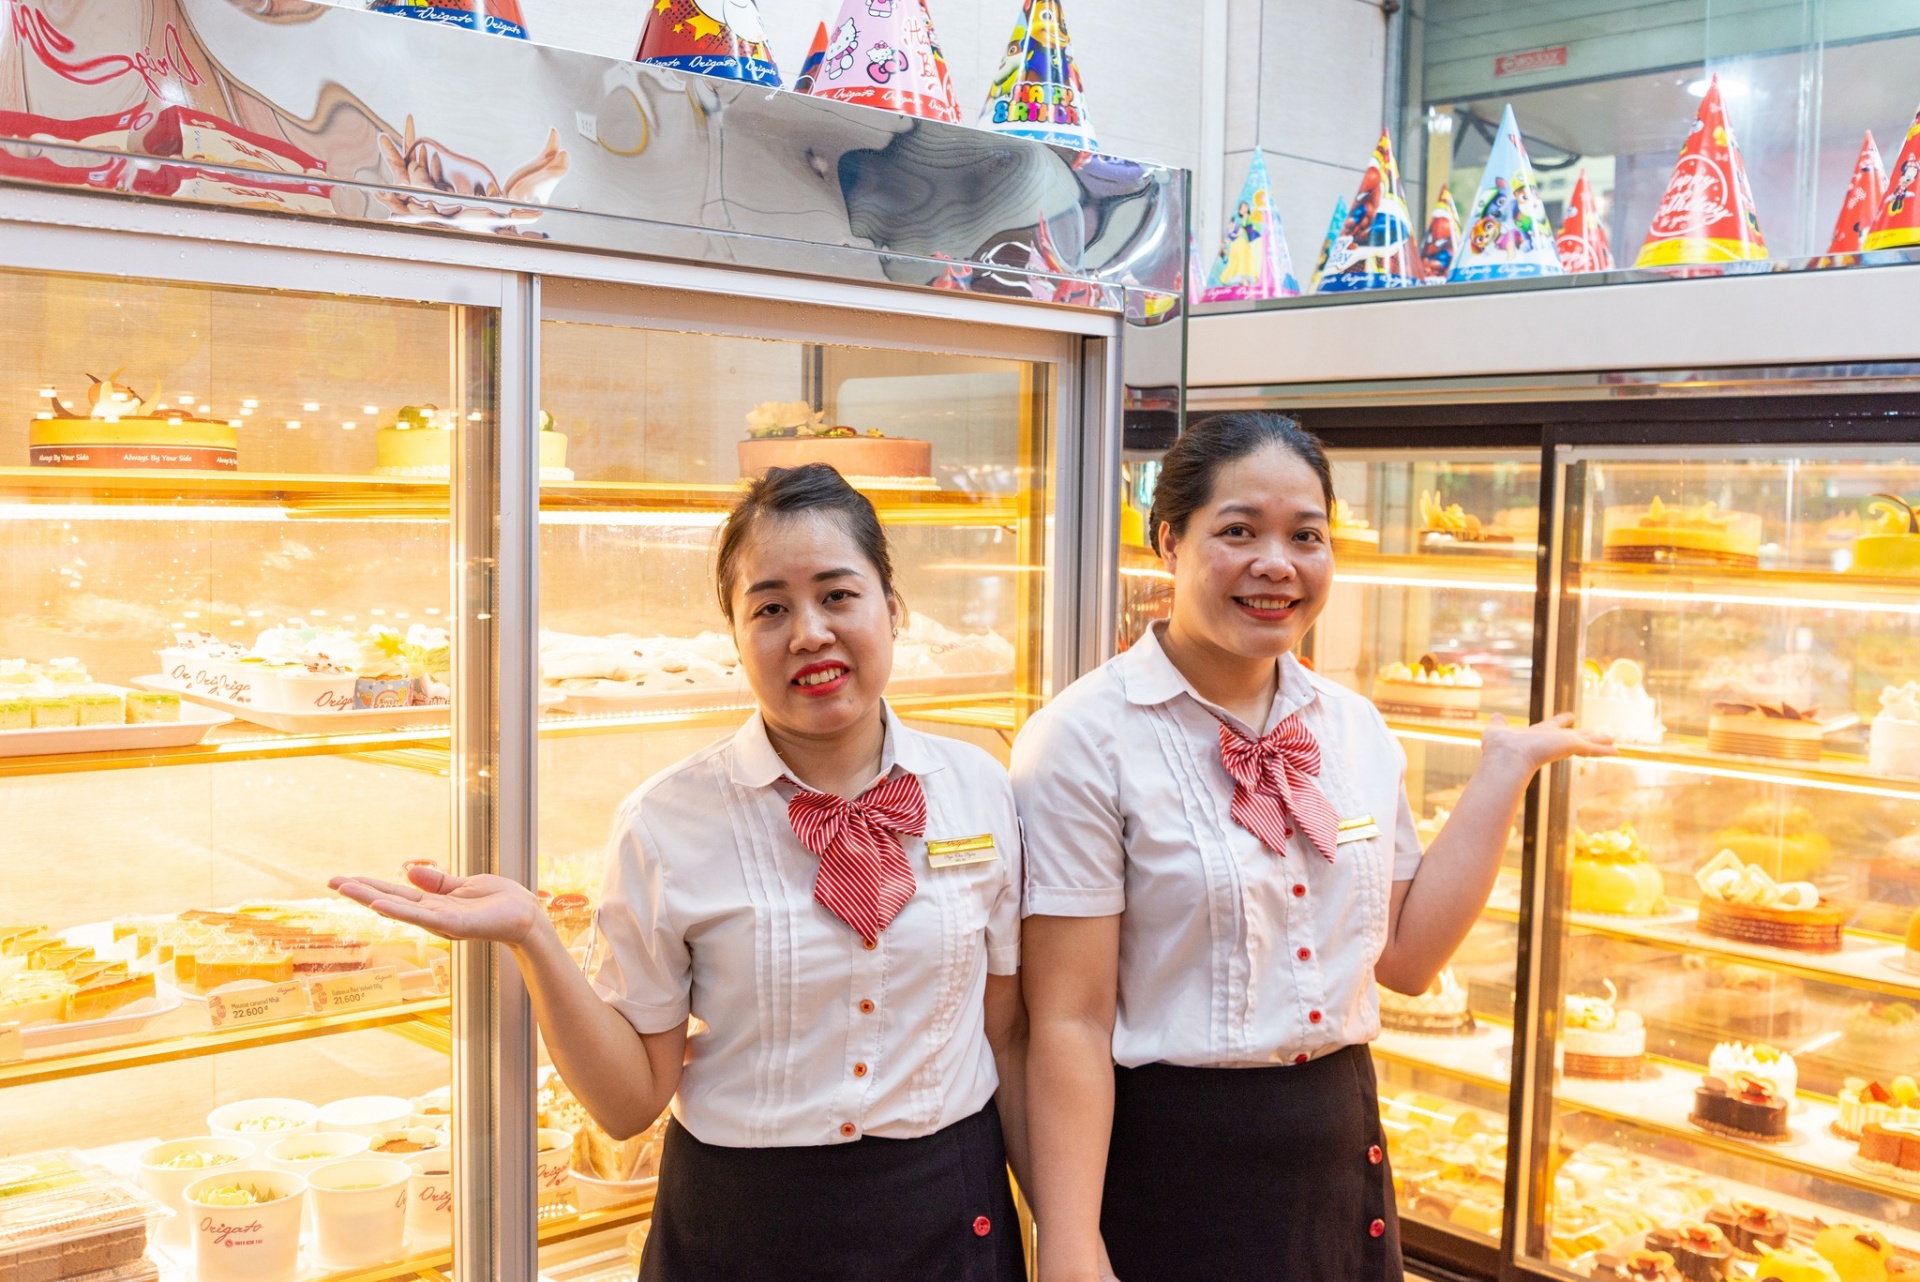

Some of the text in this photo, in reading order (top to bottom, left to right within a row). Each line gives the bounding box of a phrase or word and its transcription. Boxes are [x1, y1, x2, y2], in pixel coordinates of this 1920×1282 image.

[417, 7, 473, 23] Origato
[484, 15, 521, 36] Origato
[688, 55, 738, 74] Origato
[745, 61, 777, 79] Origato
[833, 87, 875, 102] Origato
[1012, 82, 1074, 106] HAPPY
[61, 453, 75, 462] Your
[75, 453, 90, 462] Side
[123, 453, 192, 463] Always By Your Side
[313, 690, 354, 712] Origa
[418, 1186, 452, 1212] Orig
[200, 1216, 263, 1245] Origato
